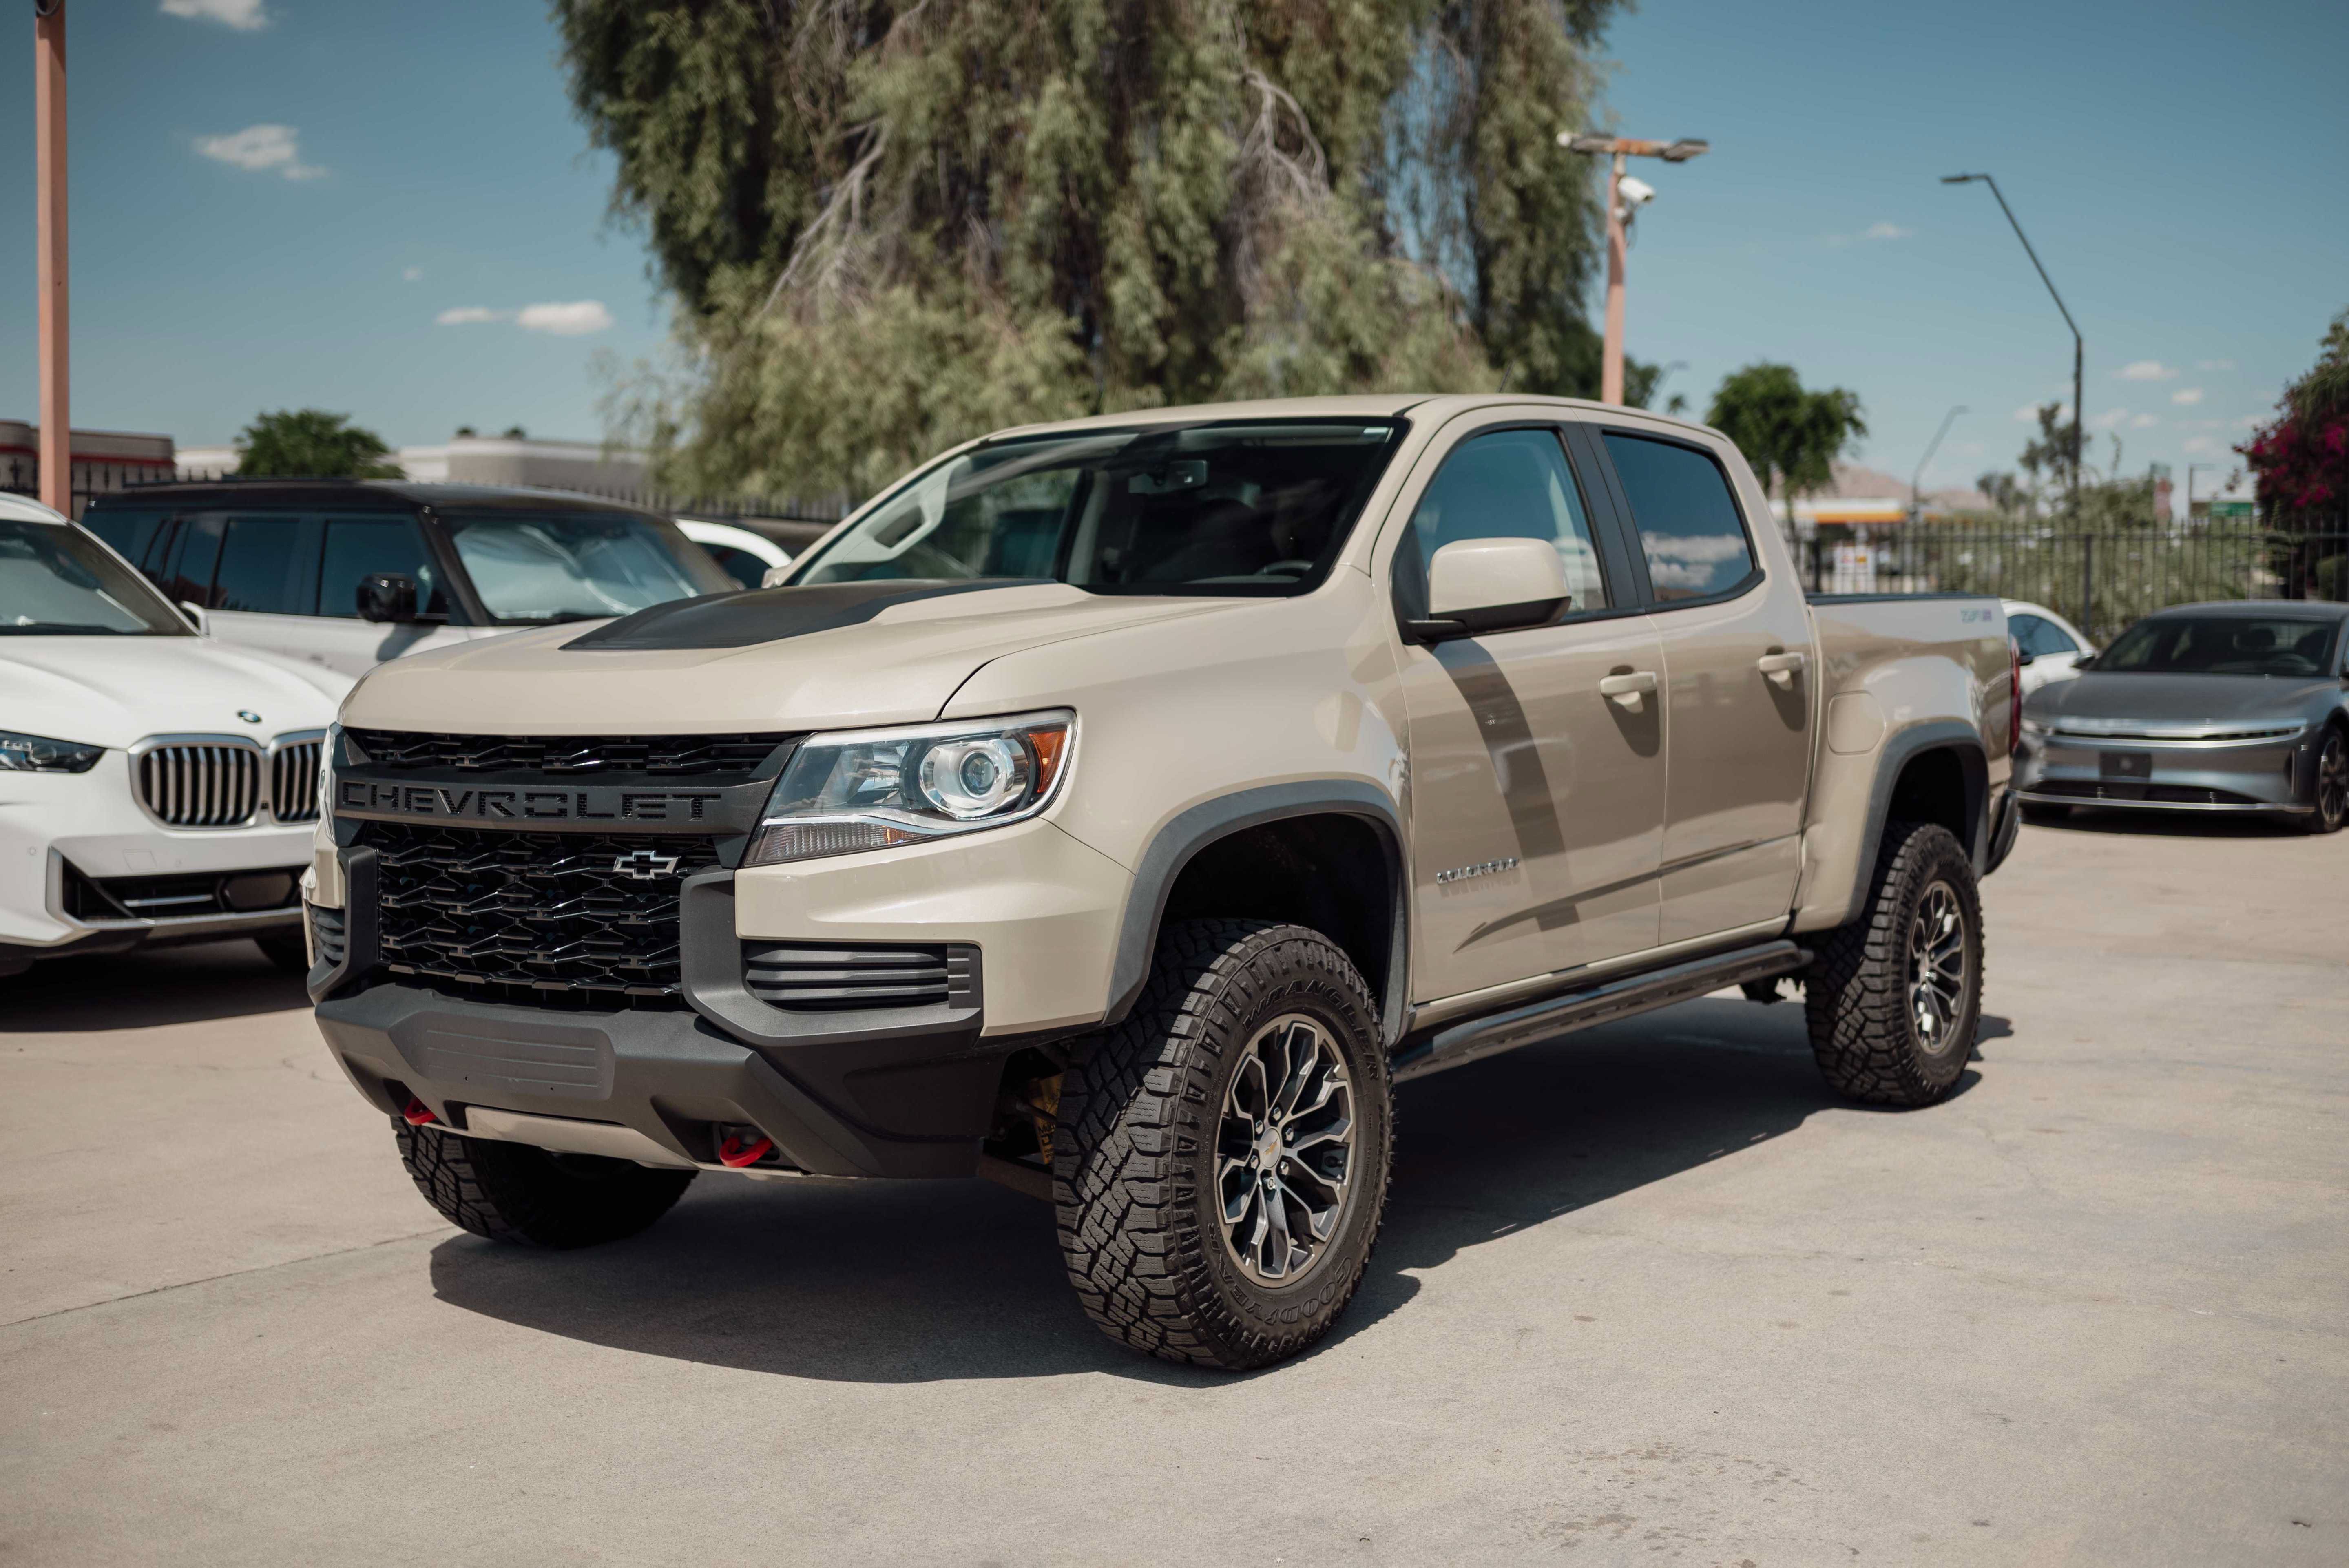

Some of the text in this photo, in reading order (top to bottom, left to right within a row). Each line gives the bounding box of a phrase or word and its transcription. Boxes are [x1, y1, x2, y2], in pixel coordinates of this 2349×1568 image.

[341, 782, 722, 820] CHEVROLET
[1436, 858, 1520, 885] COLORADO
[1242, 978, 1379, 1081] WRANGLER
[1207, 1222, 1351, 1326] GOODYEAR
